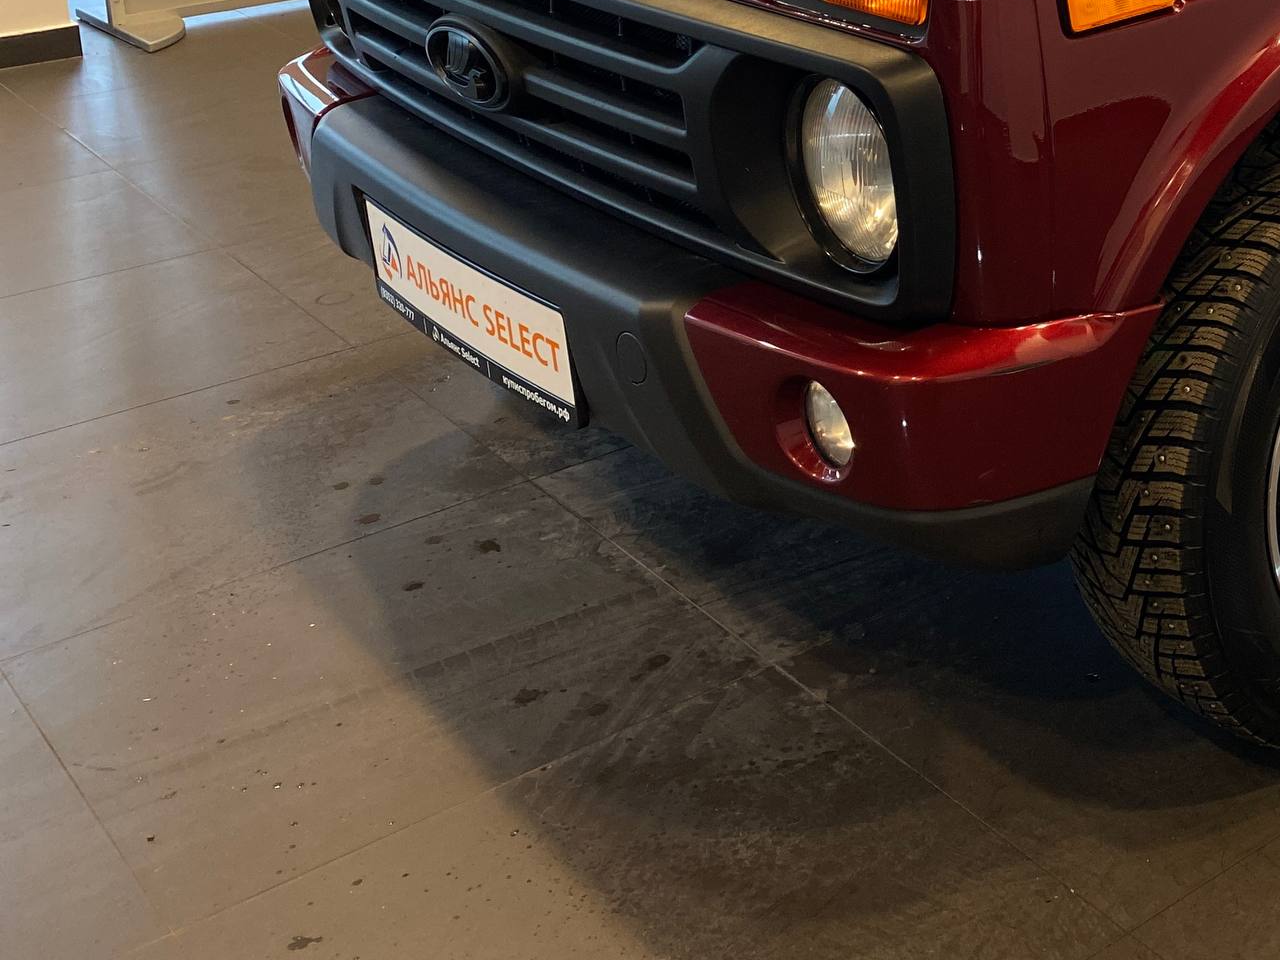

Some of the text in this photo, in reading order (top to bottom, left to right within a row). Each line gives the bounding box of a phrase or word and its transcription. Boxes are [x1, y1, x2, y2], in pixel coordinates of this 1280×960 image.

[406, 255, 561, 372] АЛЬЯНС SELECT
[502, 375, 571, 423] куписпробегом.рф
